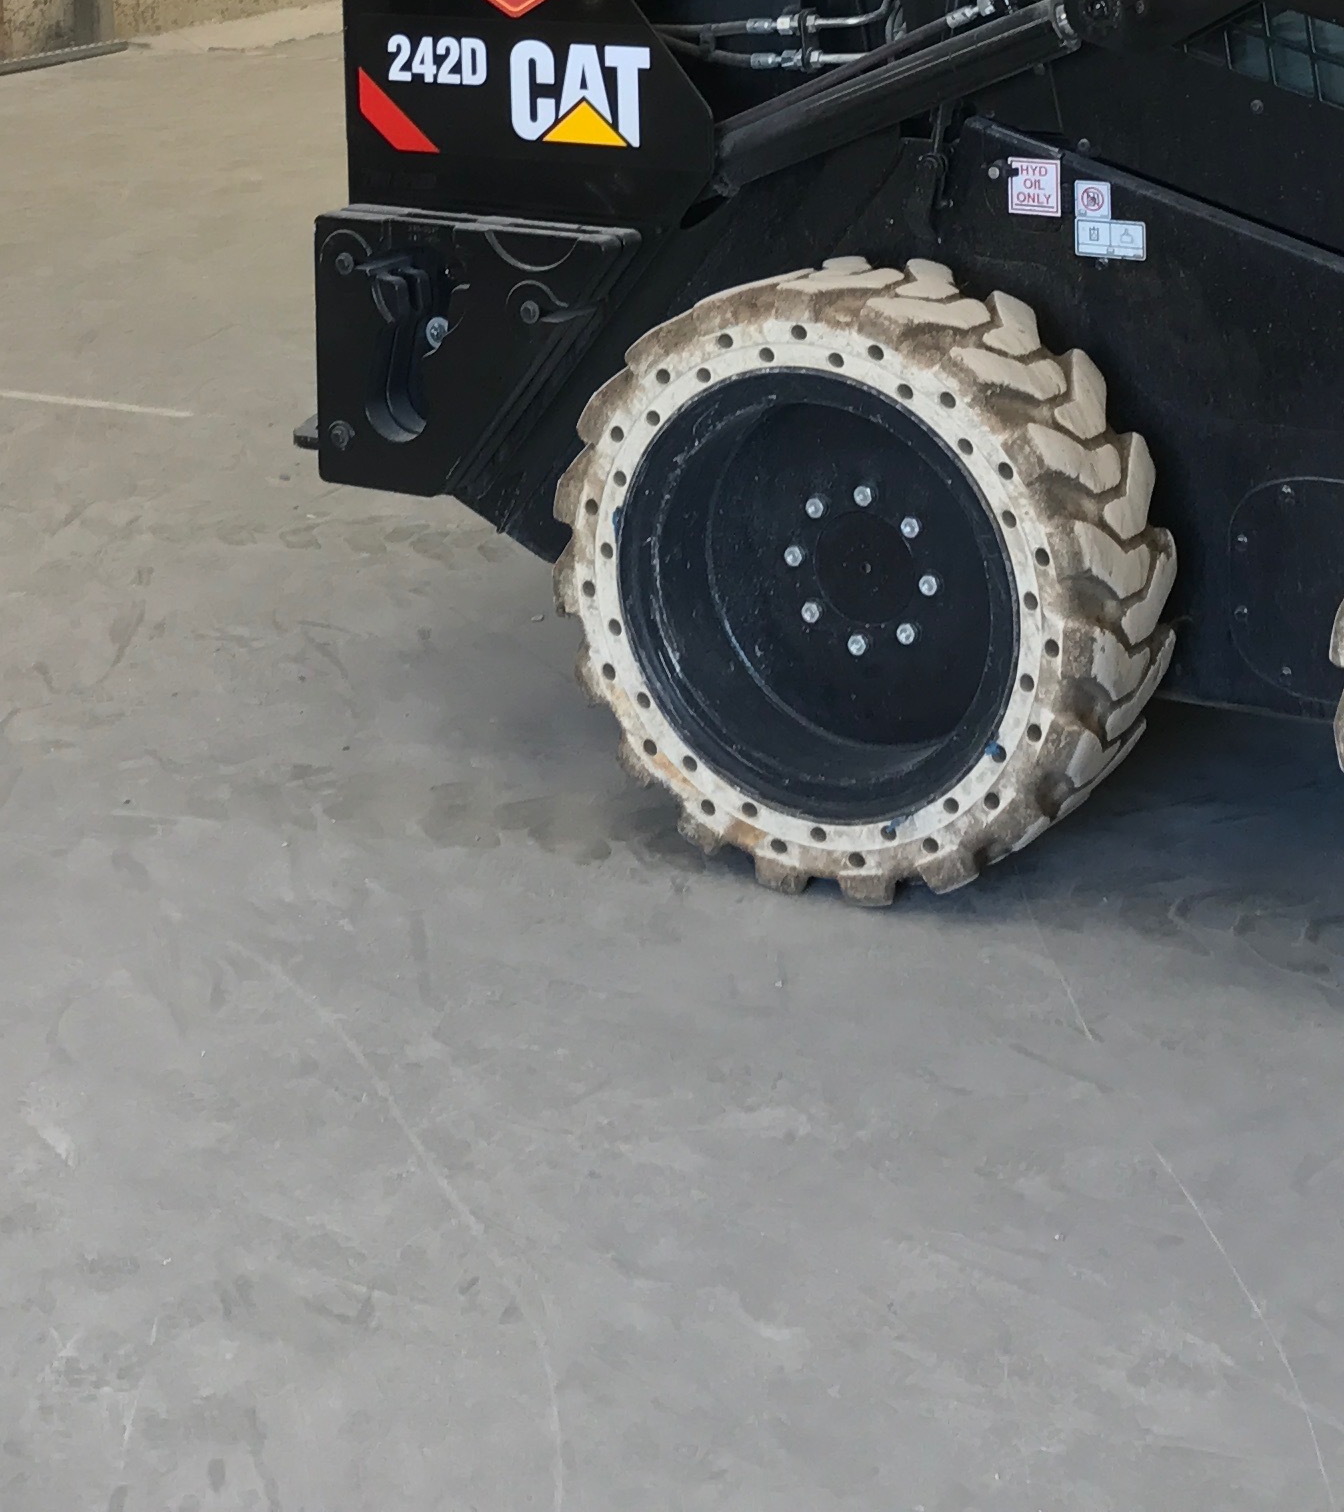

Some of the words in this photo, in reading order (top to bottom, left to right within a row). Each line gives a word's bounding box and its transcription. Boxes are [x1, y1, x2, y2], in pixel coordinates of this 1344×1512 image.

[387, 34, 488, 86] 242D
[509, 39, 650, 148] CAT
[1020, 164, 1048, 177] HYD
[1023, 178, 1045, 190] OIL
[1016, 191, 1051, 205] ONLY
